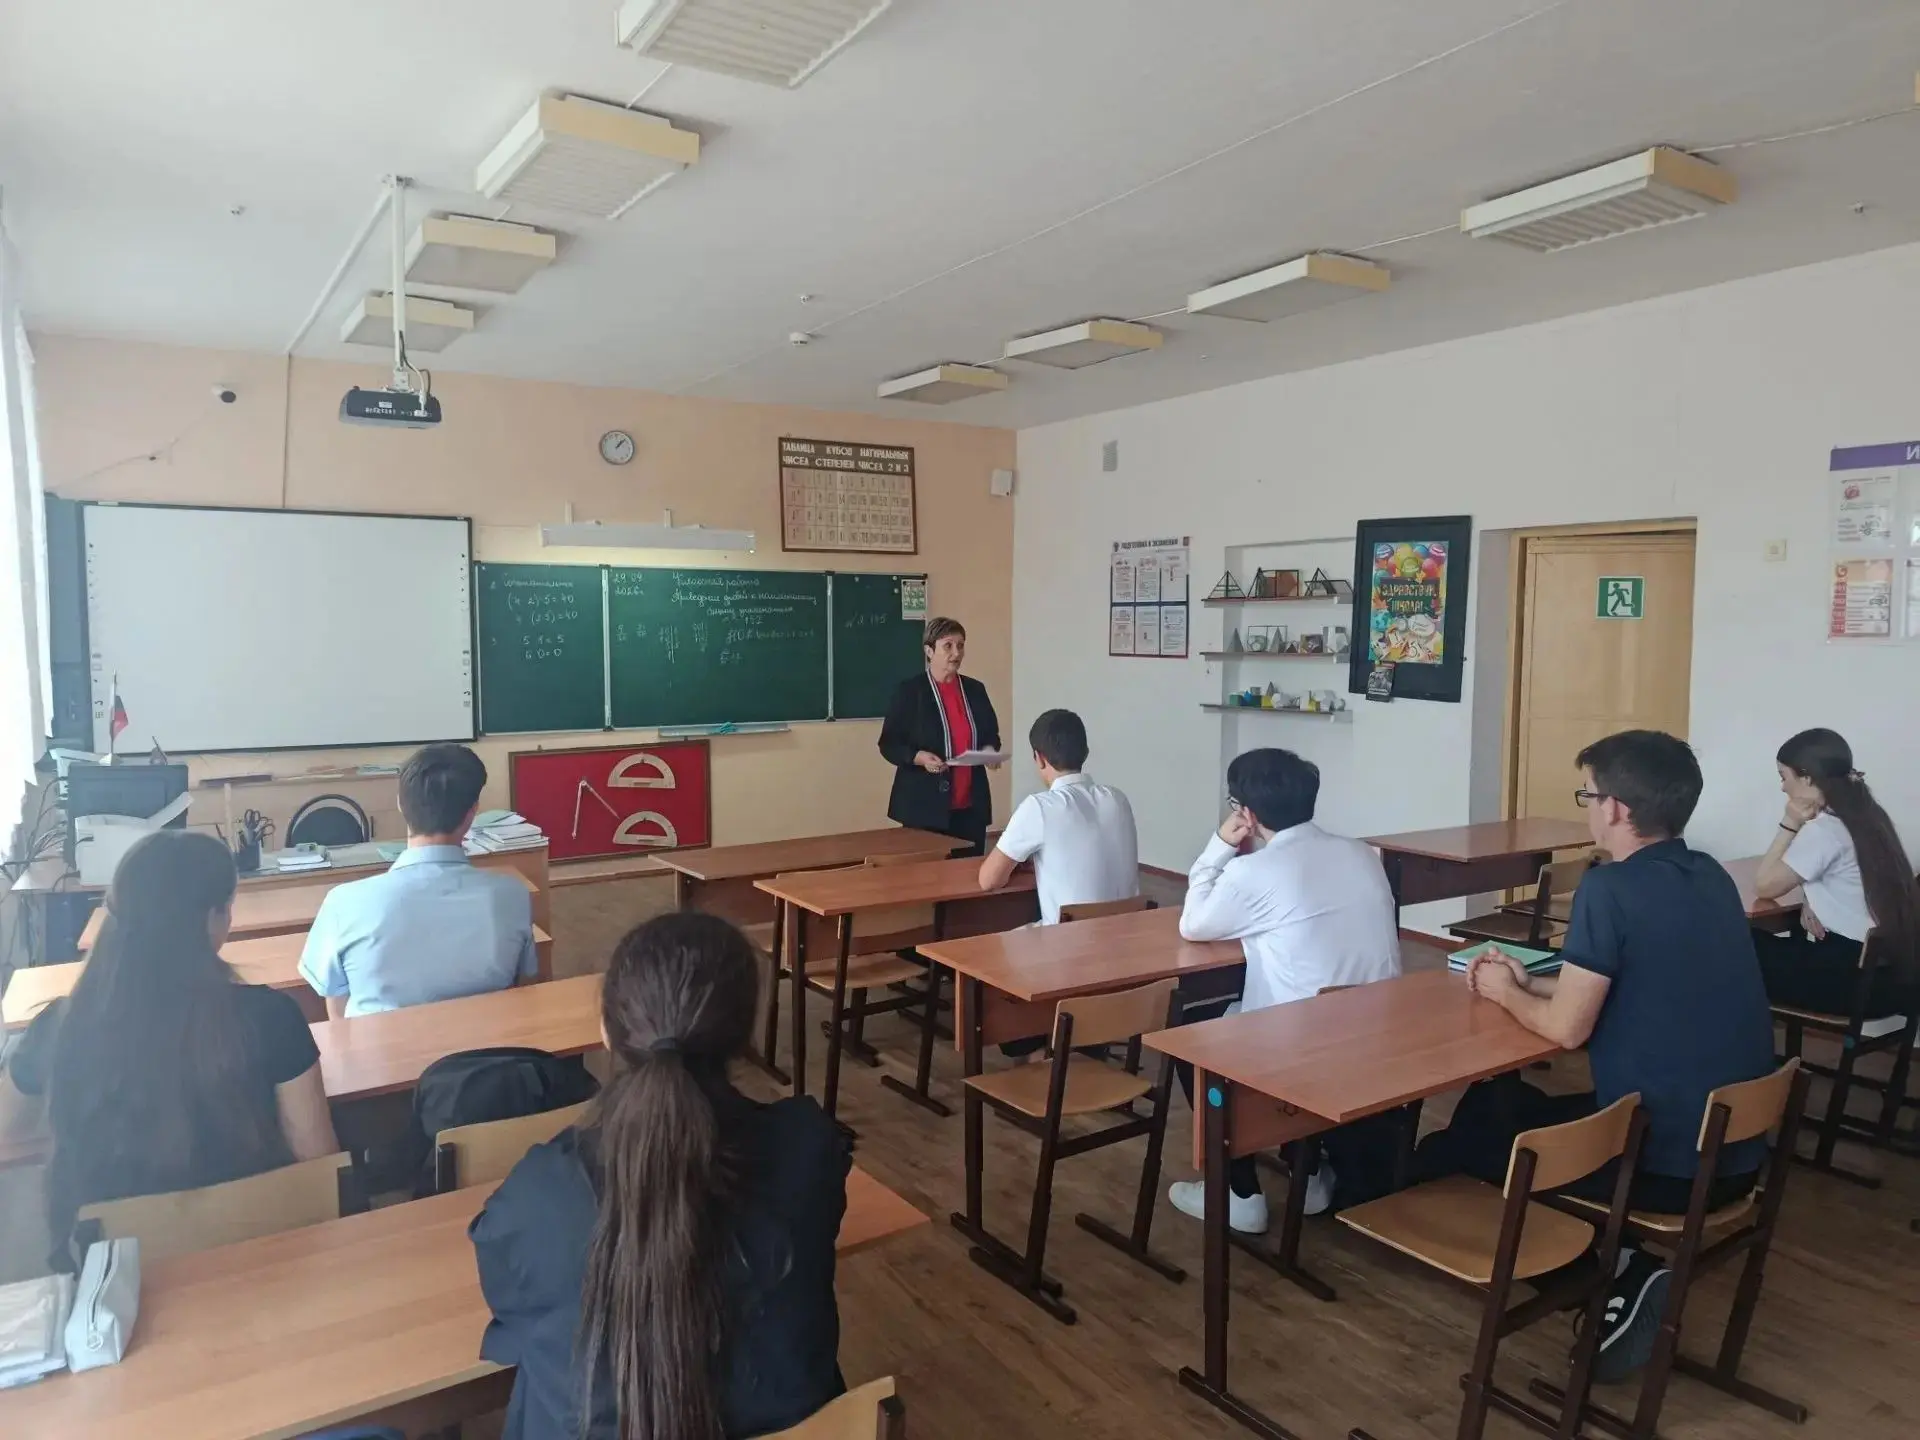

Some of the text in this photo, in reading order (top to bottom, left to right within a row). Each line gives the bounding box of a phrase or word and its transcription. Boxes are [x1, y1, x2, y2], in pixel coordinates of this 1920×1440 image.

[782, 442, 815, 453] ТАБЛИЦА
[826, 446, 852, 456] КУБОВ
[782, 456, 809, 466] ЧИСЕЛ
[858, 461, 883, 471] ЧИСЕЛ
[888, 463, 893, 472] 2
